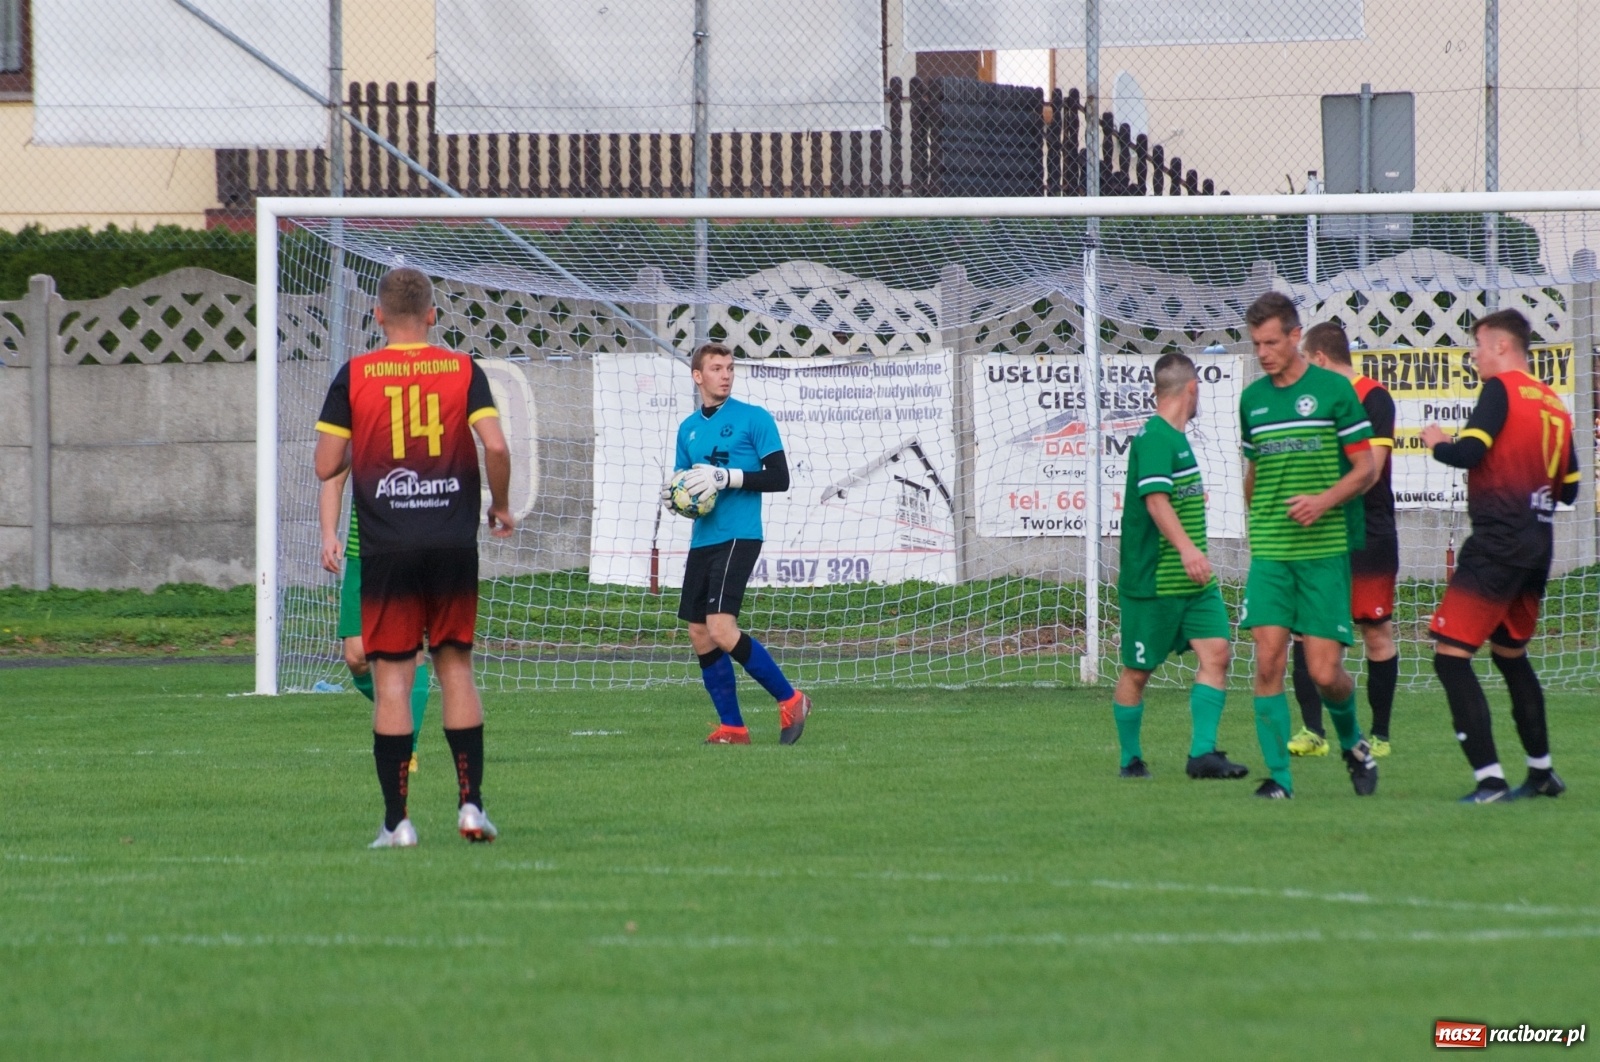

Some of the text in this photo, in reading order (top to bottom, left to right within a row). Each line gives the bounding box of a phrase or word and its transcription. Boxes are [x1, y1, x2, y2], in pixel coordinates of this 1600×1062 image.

[988, 365, 1080, 383] USŁUGI
[800, 382, 942, 401] Docieplenia budynków
[384, 384, 444, 460] 14
[896, 406, 943, 423] wnętrz
[1424, 404, 1472, 421] Produ
[375, 475, 460, 499] Alabama
[389, 498, 450, 509] Tour&Holiday
[1009, 490, 1047, 510] tel.
[1057, 490, 1087, 510] 66
[1395, 491, 1448, 503] kowice,
[776, 558, 819, 583] 507
[827, 558, 870, 583] 320
[1135, 641, 1146, 664] 2
